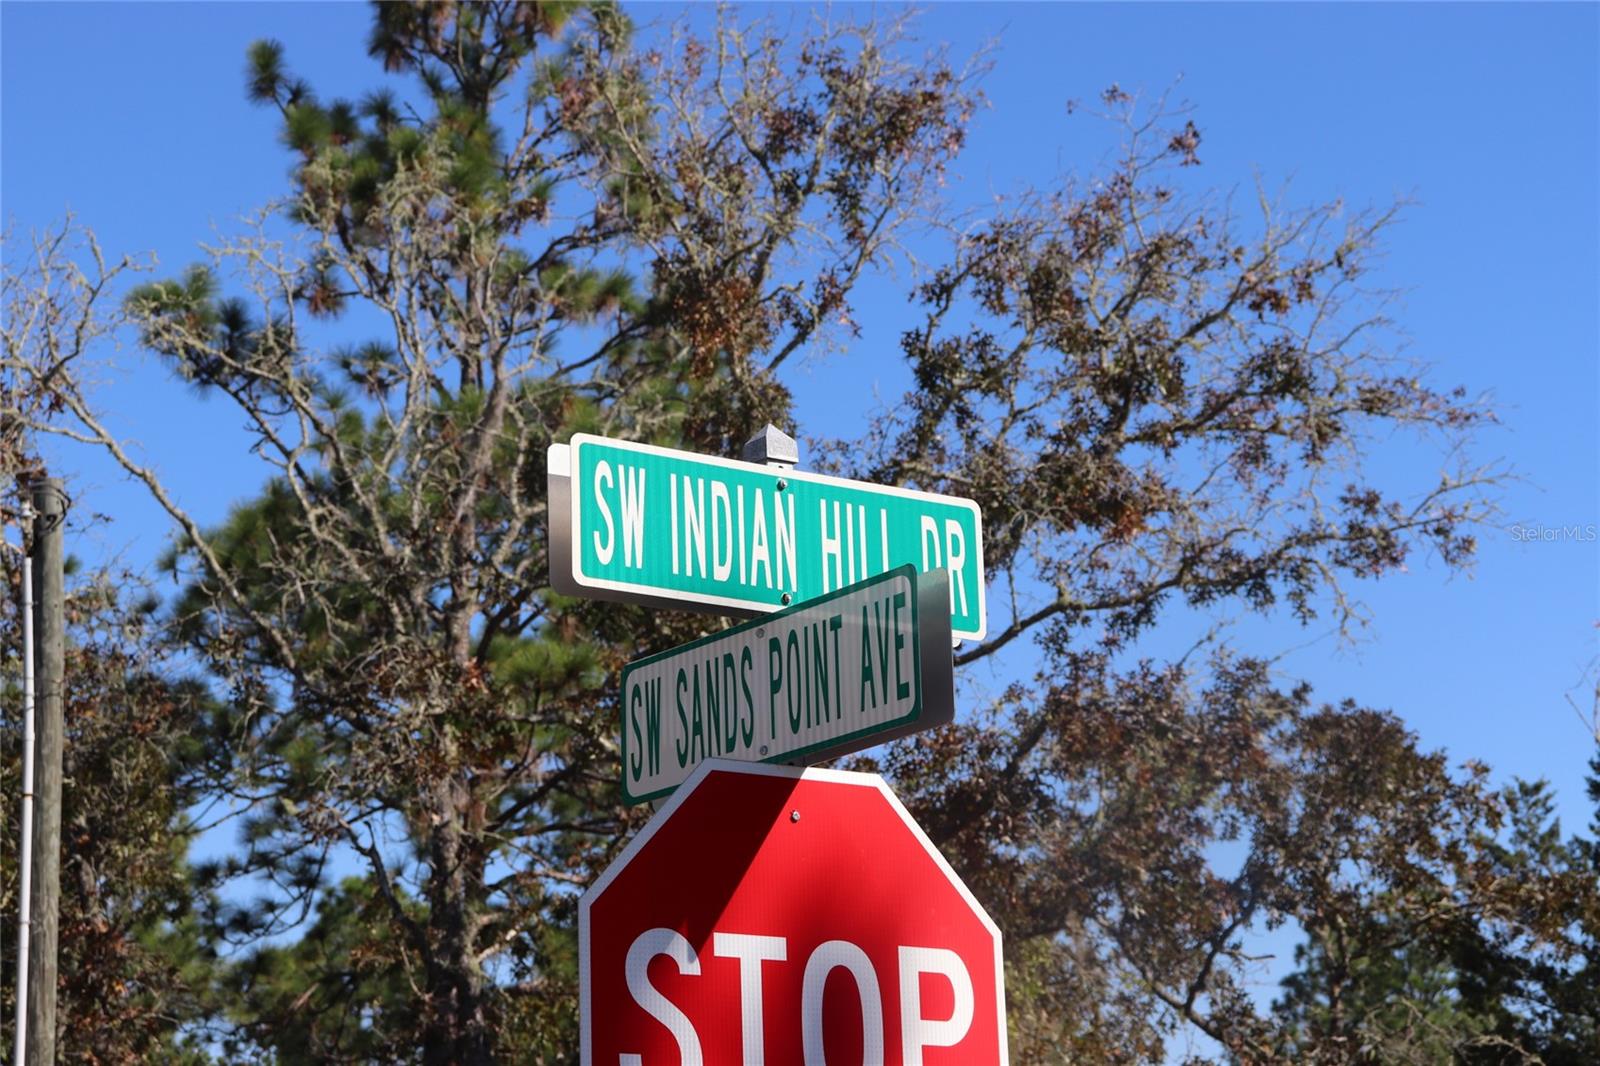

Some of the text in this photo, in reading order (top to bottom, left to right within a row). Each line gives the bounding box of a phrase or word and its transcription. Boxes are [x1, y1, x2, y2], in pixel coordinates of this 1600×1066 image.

[593, 459, 646, 569] SW
[669, 473, 798, 593] INDIAN
[630, 591, 910, 782] SW SANDS POINT AVE
[619, 927, 975, 1066] STOP
